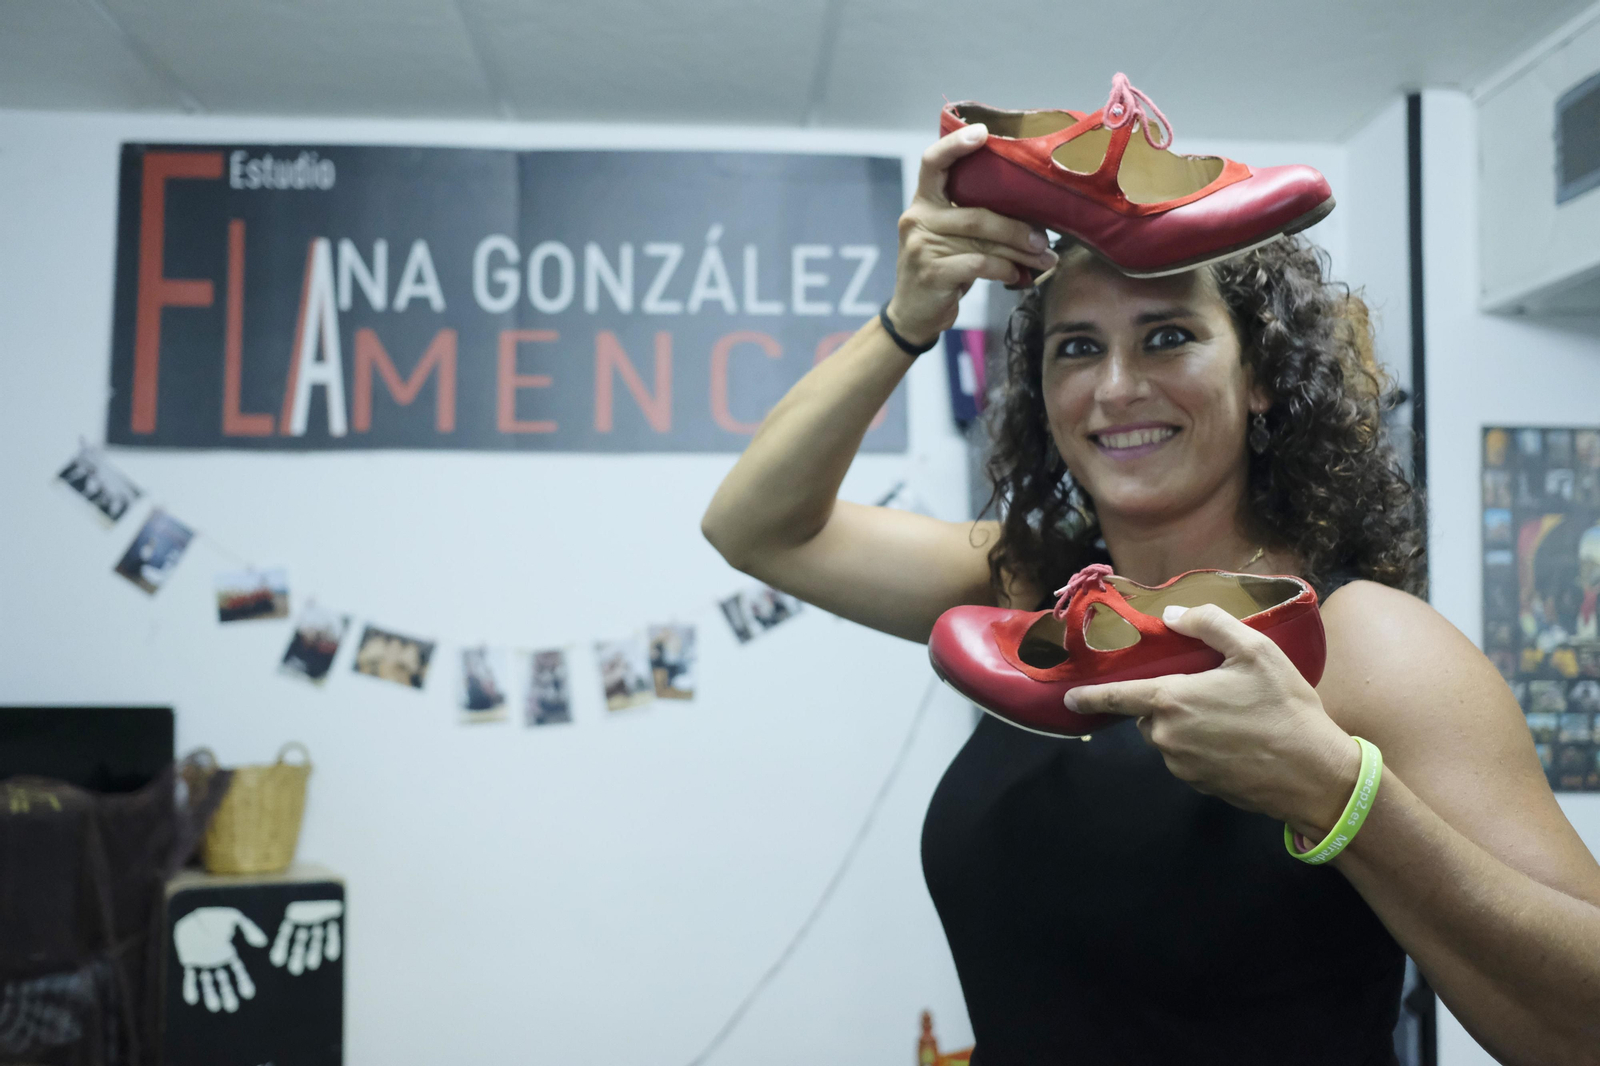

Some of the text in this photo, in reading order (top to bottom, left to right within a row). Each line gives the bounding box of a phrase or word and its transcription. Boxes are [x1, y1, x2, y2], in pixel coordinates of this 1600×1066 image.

[229, 150, 336, 190] Estudio
[130, 151, 891, 437] FLAMENC
[471, 224, 882, 316] GONZÁLEZ
